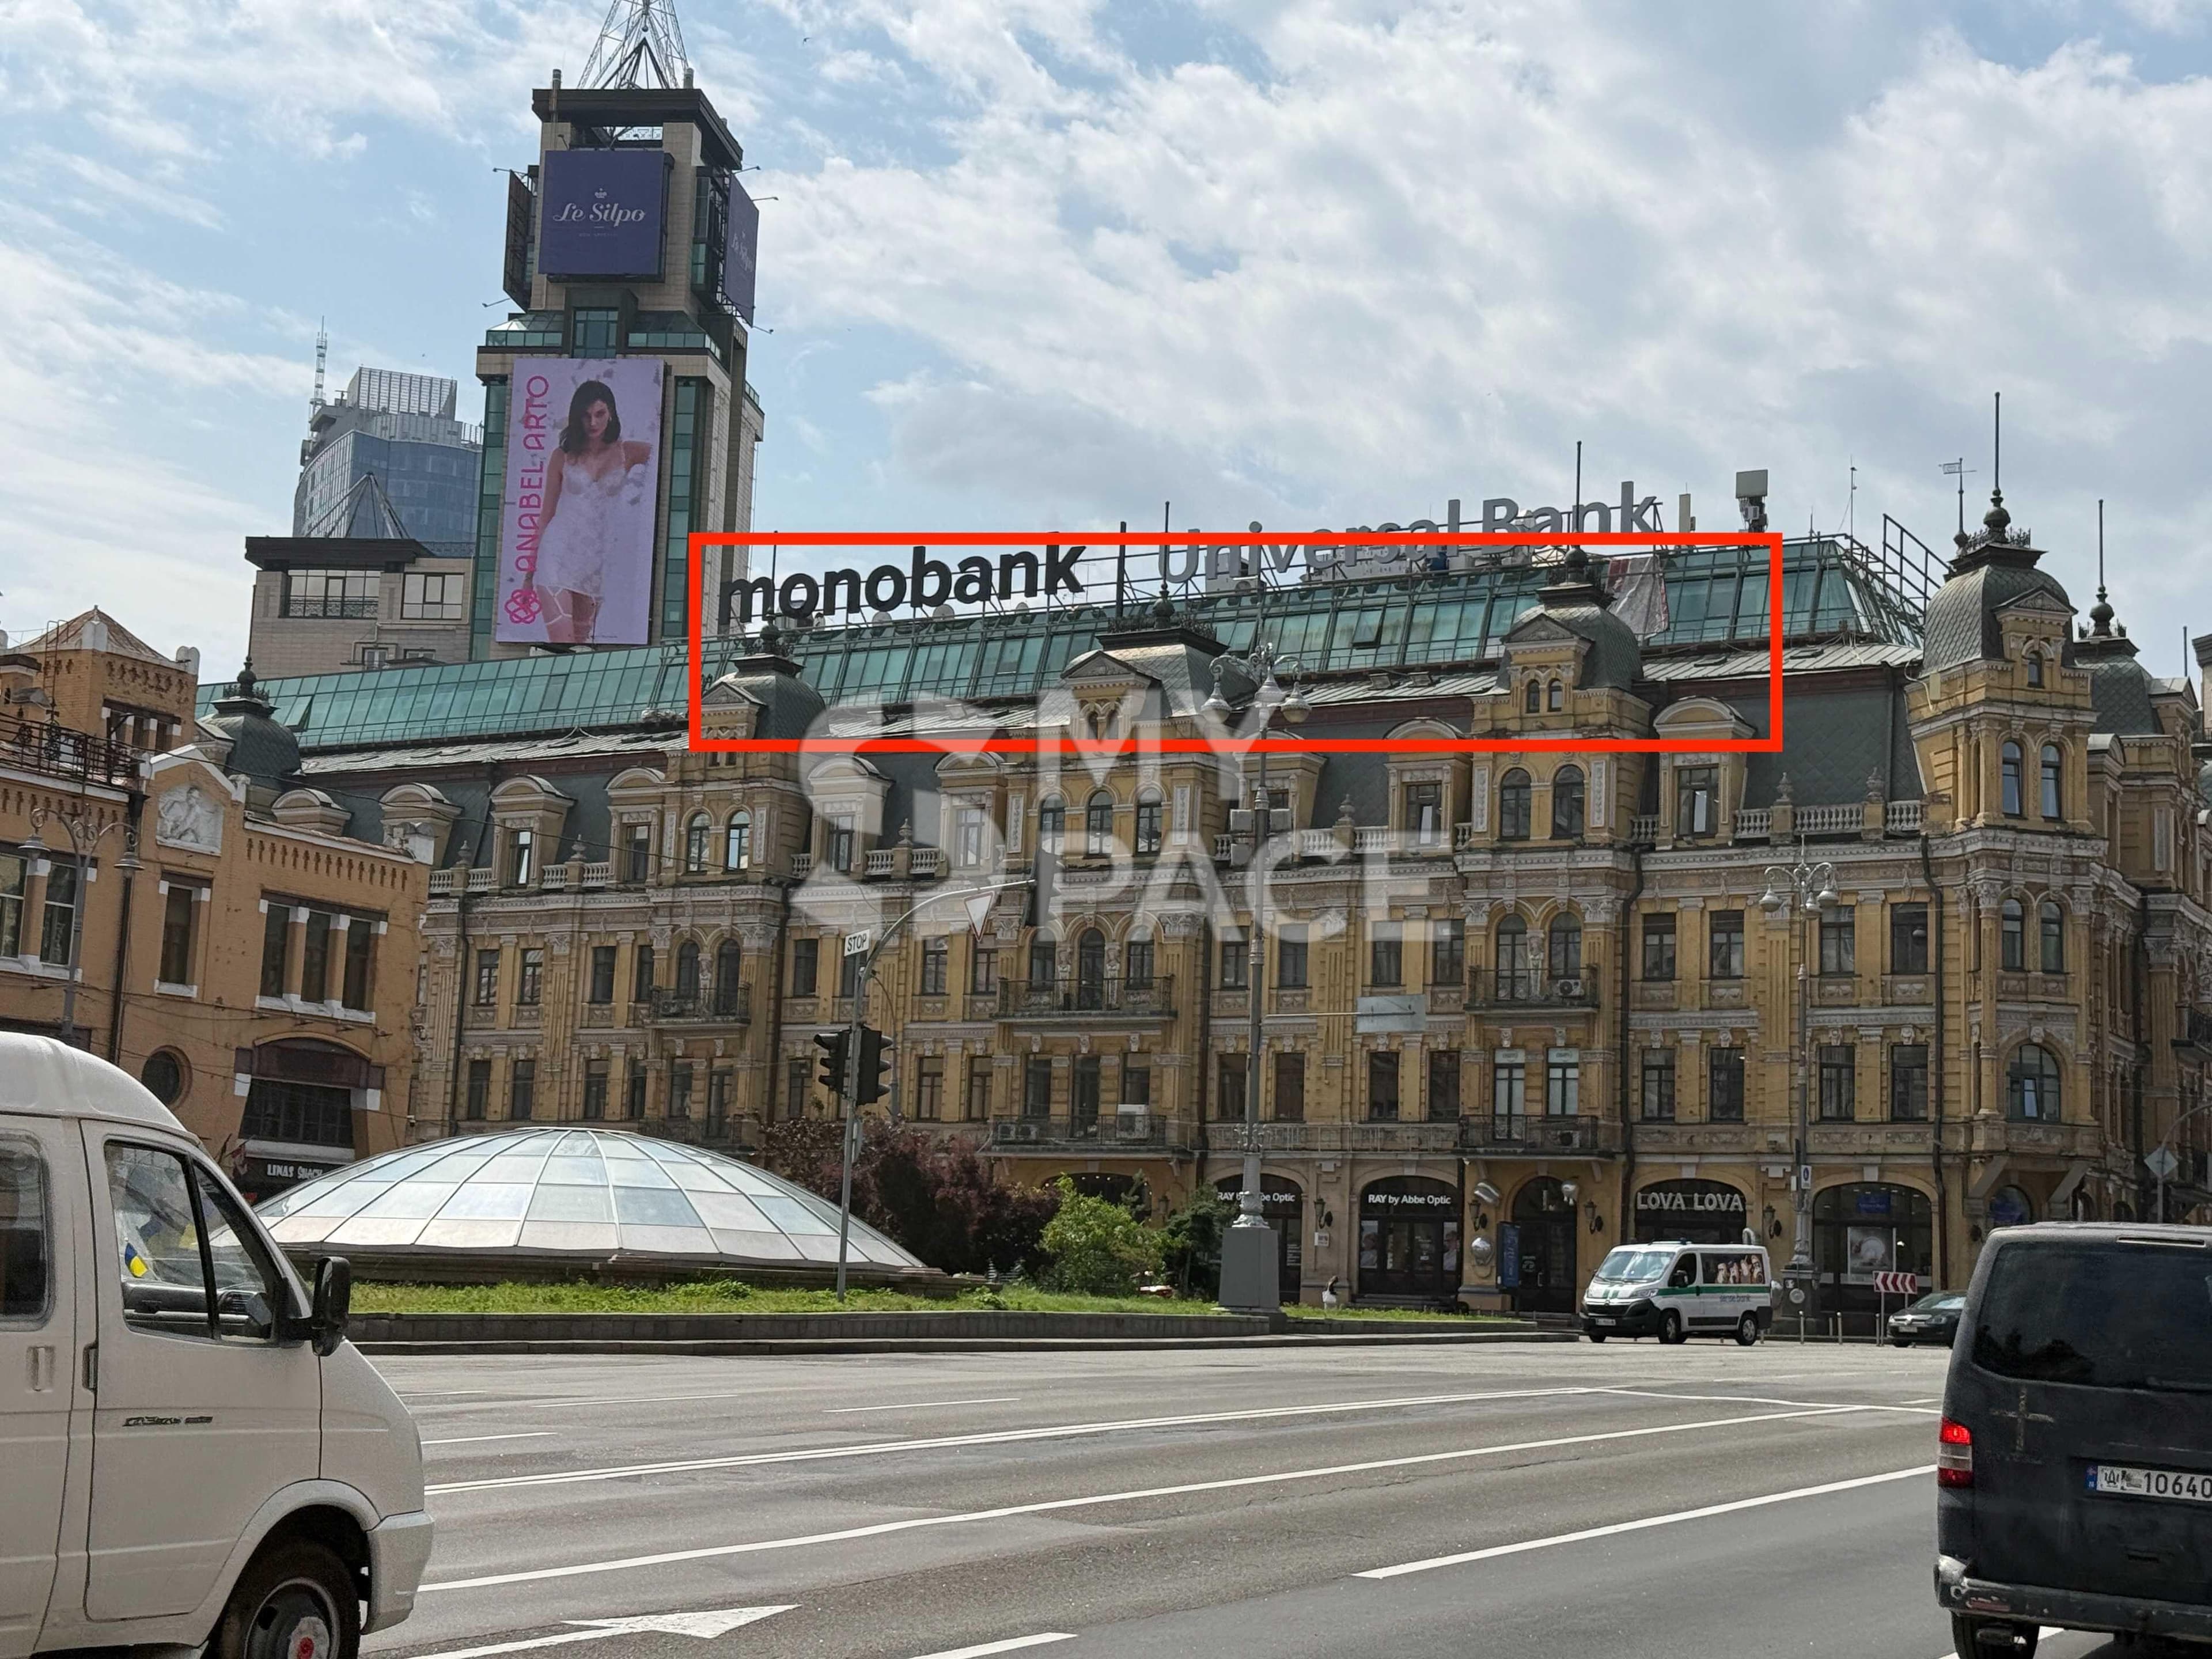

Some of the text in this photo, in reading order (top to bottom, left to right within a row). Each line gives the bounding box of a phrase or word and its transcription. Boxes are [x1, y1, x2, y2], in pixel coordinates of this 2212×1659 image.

[552, 203, 646, 227] Le Silpo
[515, 376, 549, 571] ANABEL ARTO
[1158, 481, 1657, 584] Universal Bank
[719, 531, 1086, 625] monobank
[847, 933, 867, 952] STOP
[1217, 1192, 1234, 1201] RAY
[1272, 1192, 1295, 1203] Optic
[1368, 1194, 1451, 1206] RAY by Abbe Optic
[1637, 1192, 1744, 1211] LOVA LOVA
